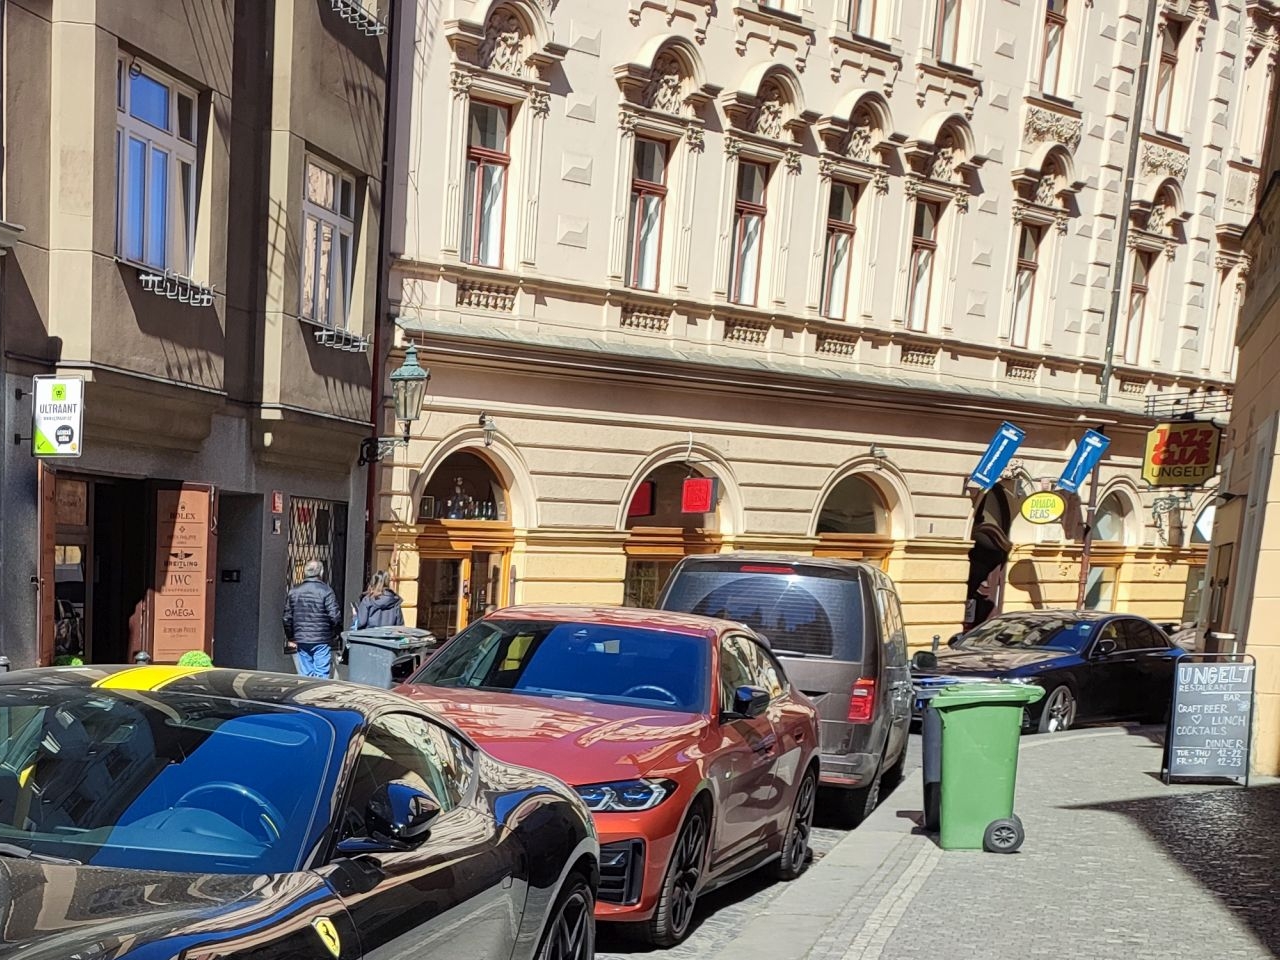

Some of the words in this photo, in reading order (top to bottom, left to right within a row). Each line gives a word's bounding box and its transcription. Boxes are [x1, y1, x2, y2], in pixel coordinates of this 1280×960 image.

[39, 403, 78, 414] ULTRAANT
[1153, 428, 1214, 451] JAZZ
[1151, 447, 1210, 466] CLUB
[1151, 465, 1209, 478] UNGELT
[169, 512, 196, 520] ROLEX
[1030, 509, 1050, 519] BEAS
[163, 560, 198, 569] BREITLING
[170, 574, 192, 586] IWC
[164, 608, 195, 617] OMEGA
[1179, 666, 1255, 685] UNGELT
[1179, 684, 1234, 692] RESTAURANT
[1223, 693, 1241, 702] BAR
[1178, 703, 1202, 713] CRAFT
[1203, 704, 1229, 714] BEER
[1211, 715, 1246, 727] LUNCH
[1176, 726, 1227, 736] COCKTAILS
[1205, 739, 1244, 749] DINNER
